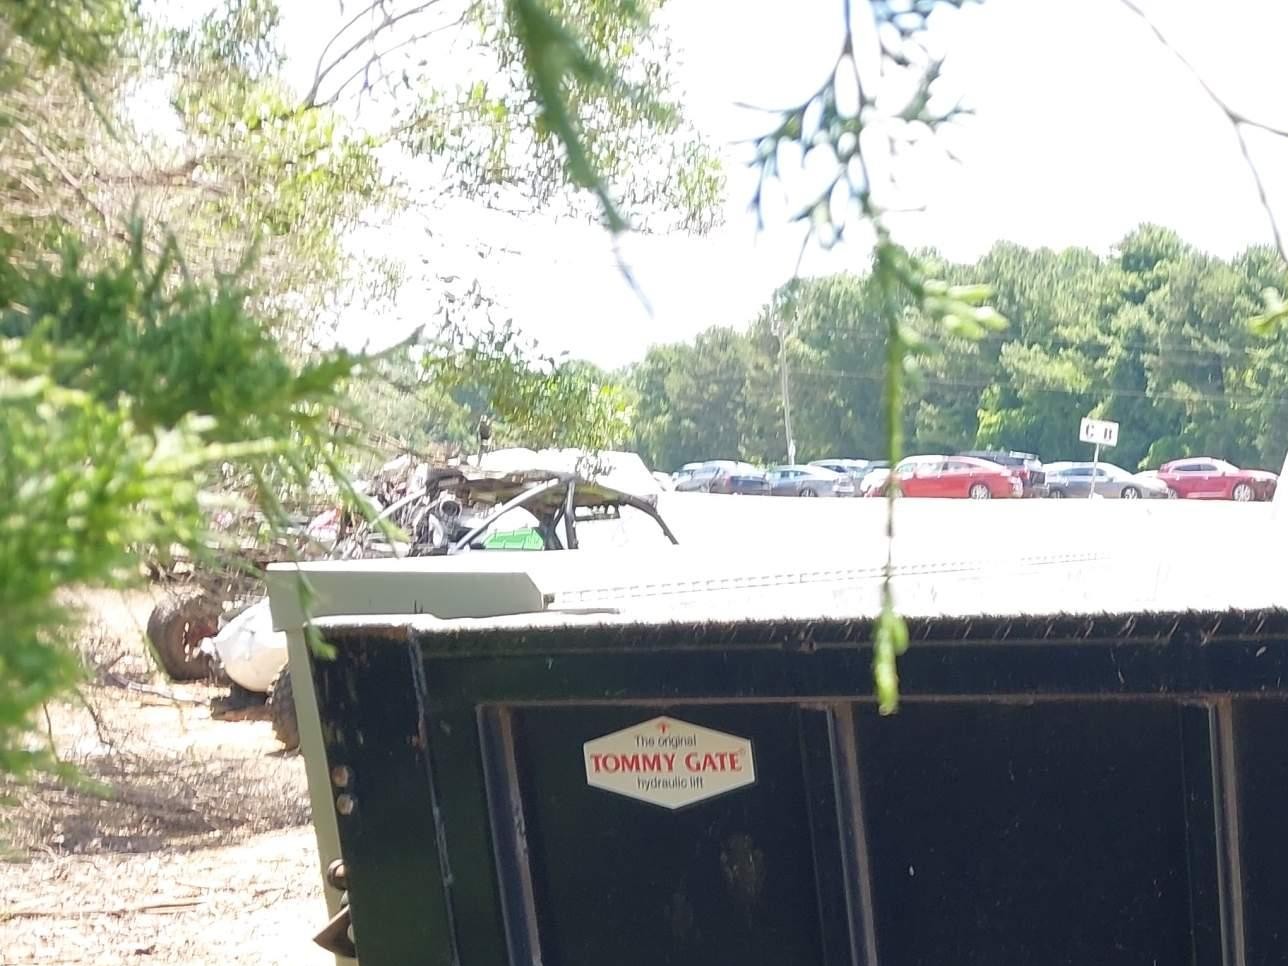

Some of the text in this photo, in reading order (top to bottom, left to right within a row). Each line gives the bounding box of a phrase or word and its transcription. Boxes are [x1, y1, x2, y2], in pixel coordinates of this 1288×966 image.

[635, 733, 697, 750] The original
[590, 751, 743, 775] TOMMY GATE
[637, 775, 704, 792] hydraulic lift
